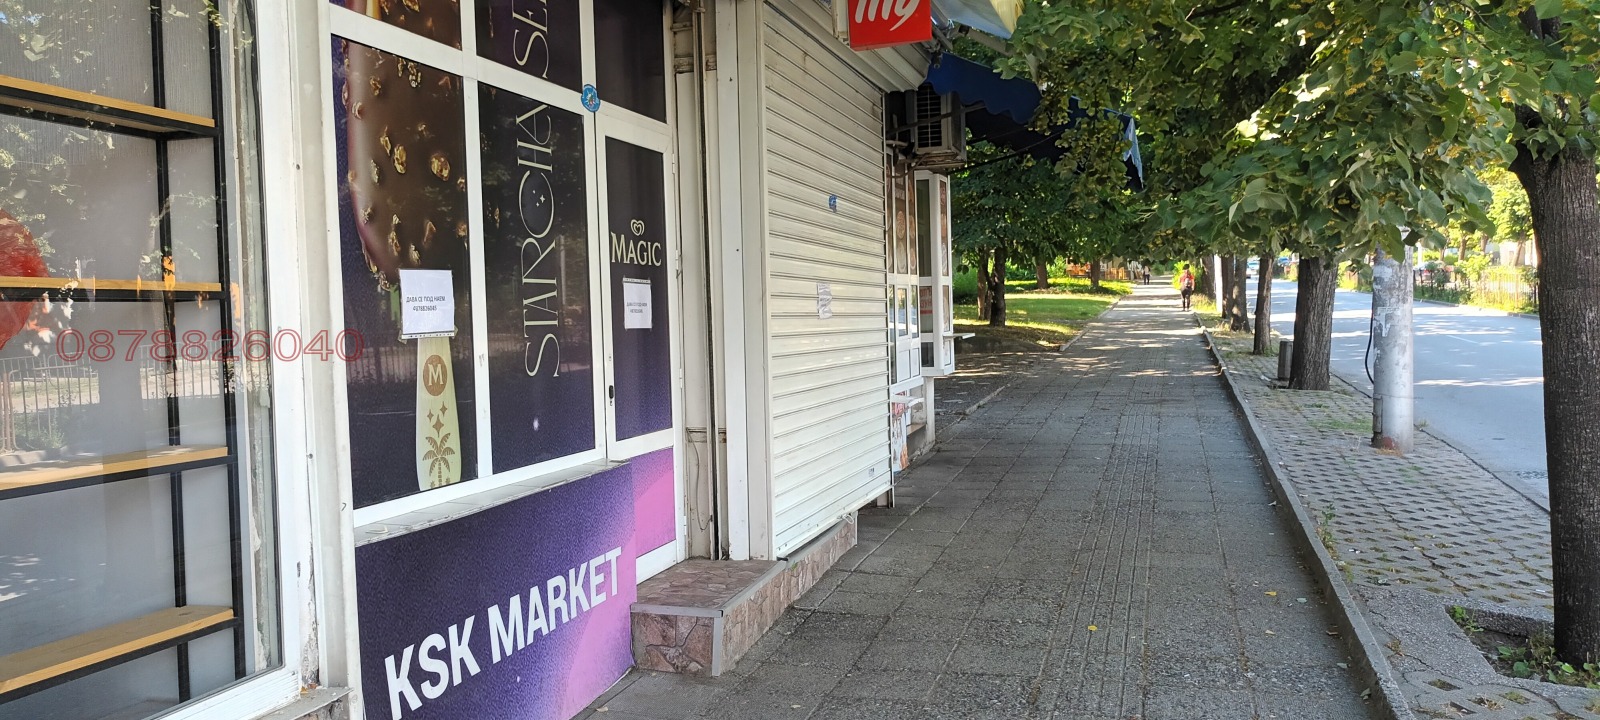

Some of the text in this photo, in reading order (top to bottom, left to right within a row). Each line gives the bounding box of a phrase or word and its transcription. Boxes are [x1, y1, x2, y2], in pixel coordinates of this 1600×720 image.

[512, 0, 560, 377] STARCHASE
[610, 231, 662, 267] MAGIC
[428, 363, 444, 386] M
[385, 546, 622, 720] KSK MARKET
